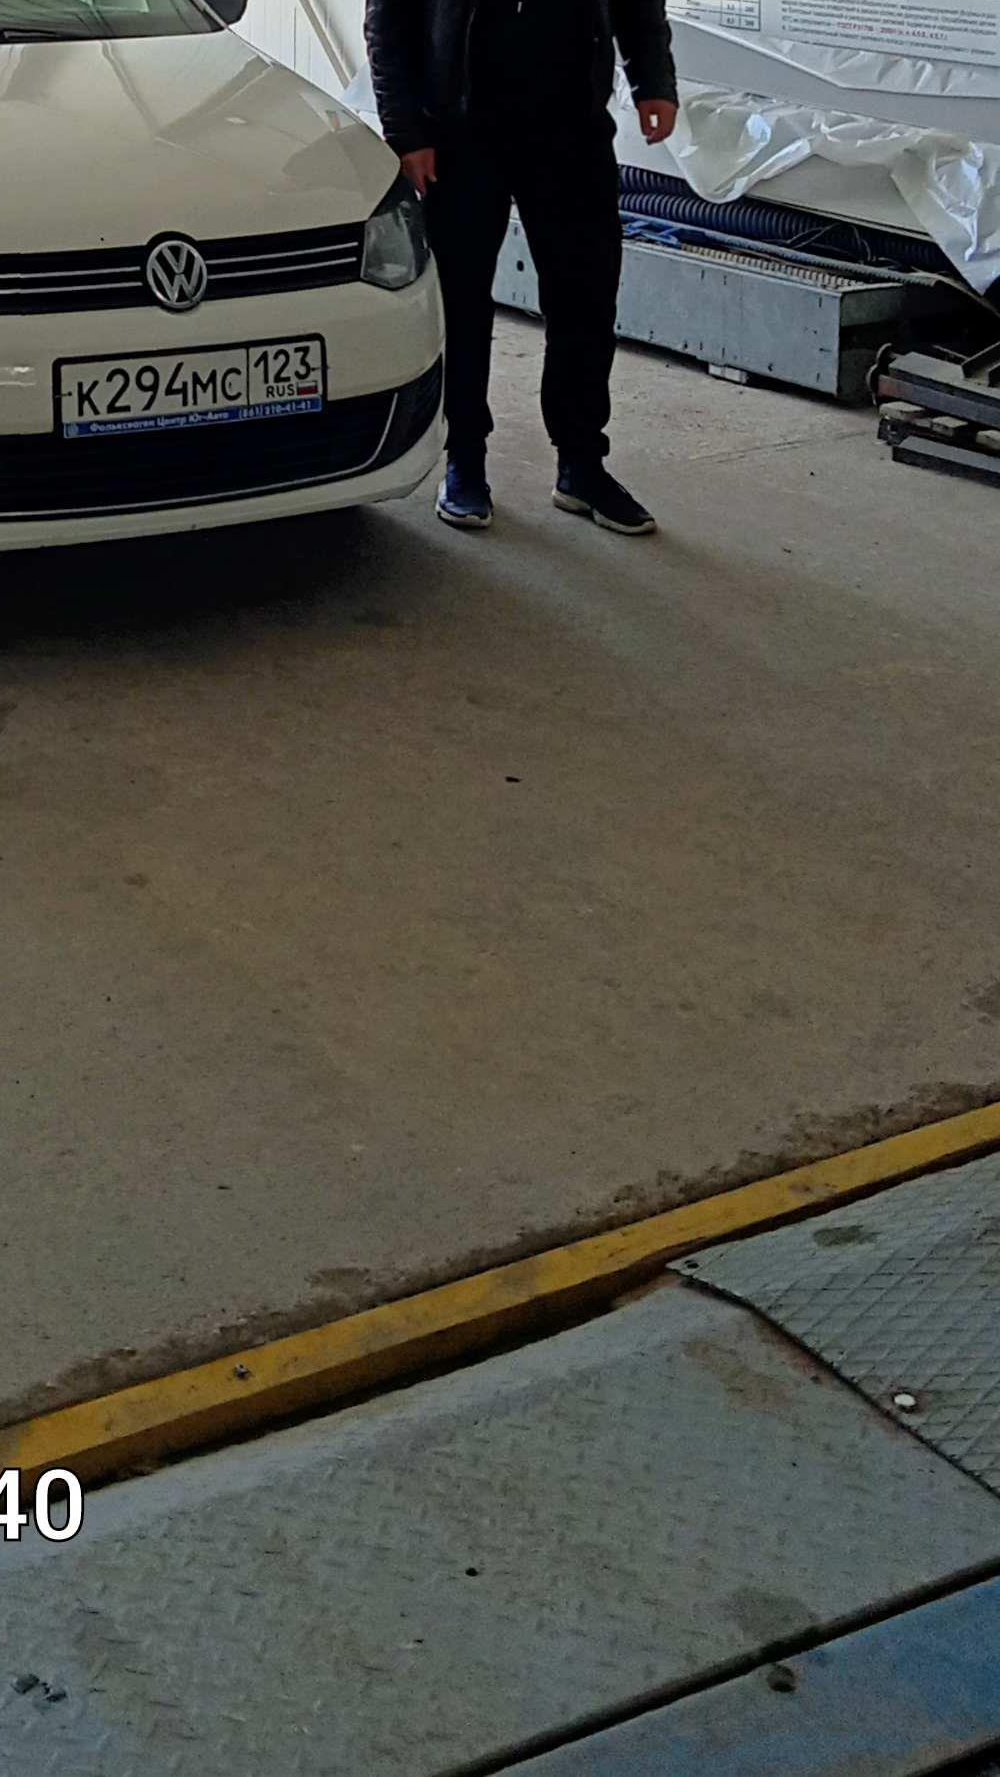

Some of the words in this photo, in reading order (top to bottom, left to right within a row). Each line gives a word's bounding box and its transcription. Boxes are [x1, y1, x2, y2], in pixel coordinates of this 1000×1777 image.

[77, 362, 242, 417] К294МС
[253, 346, 312, 384] 123
[266, 384, 295, 398] RUS
